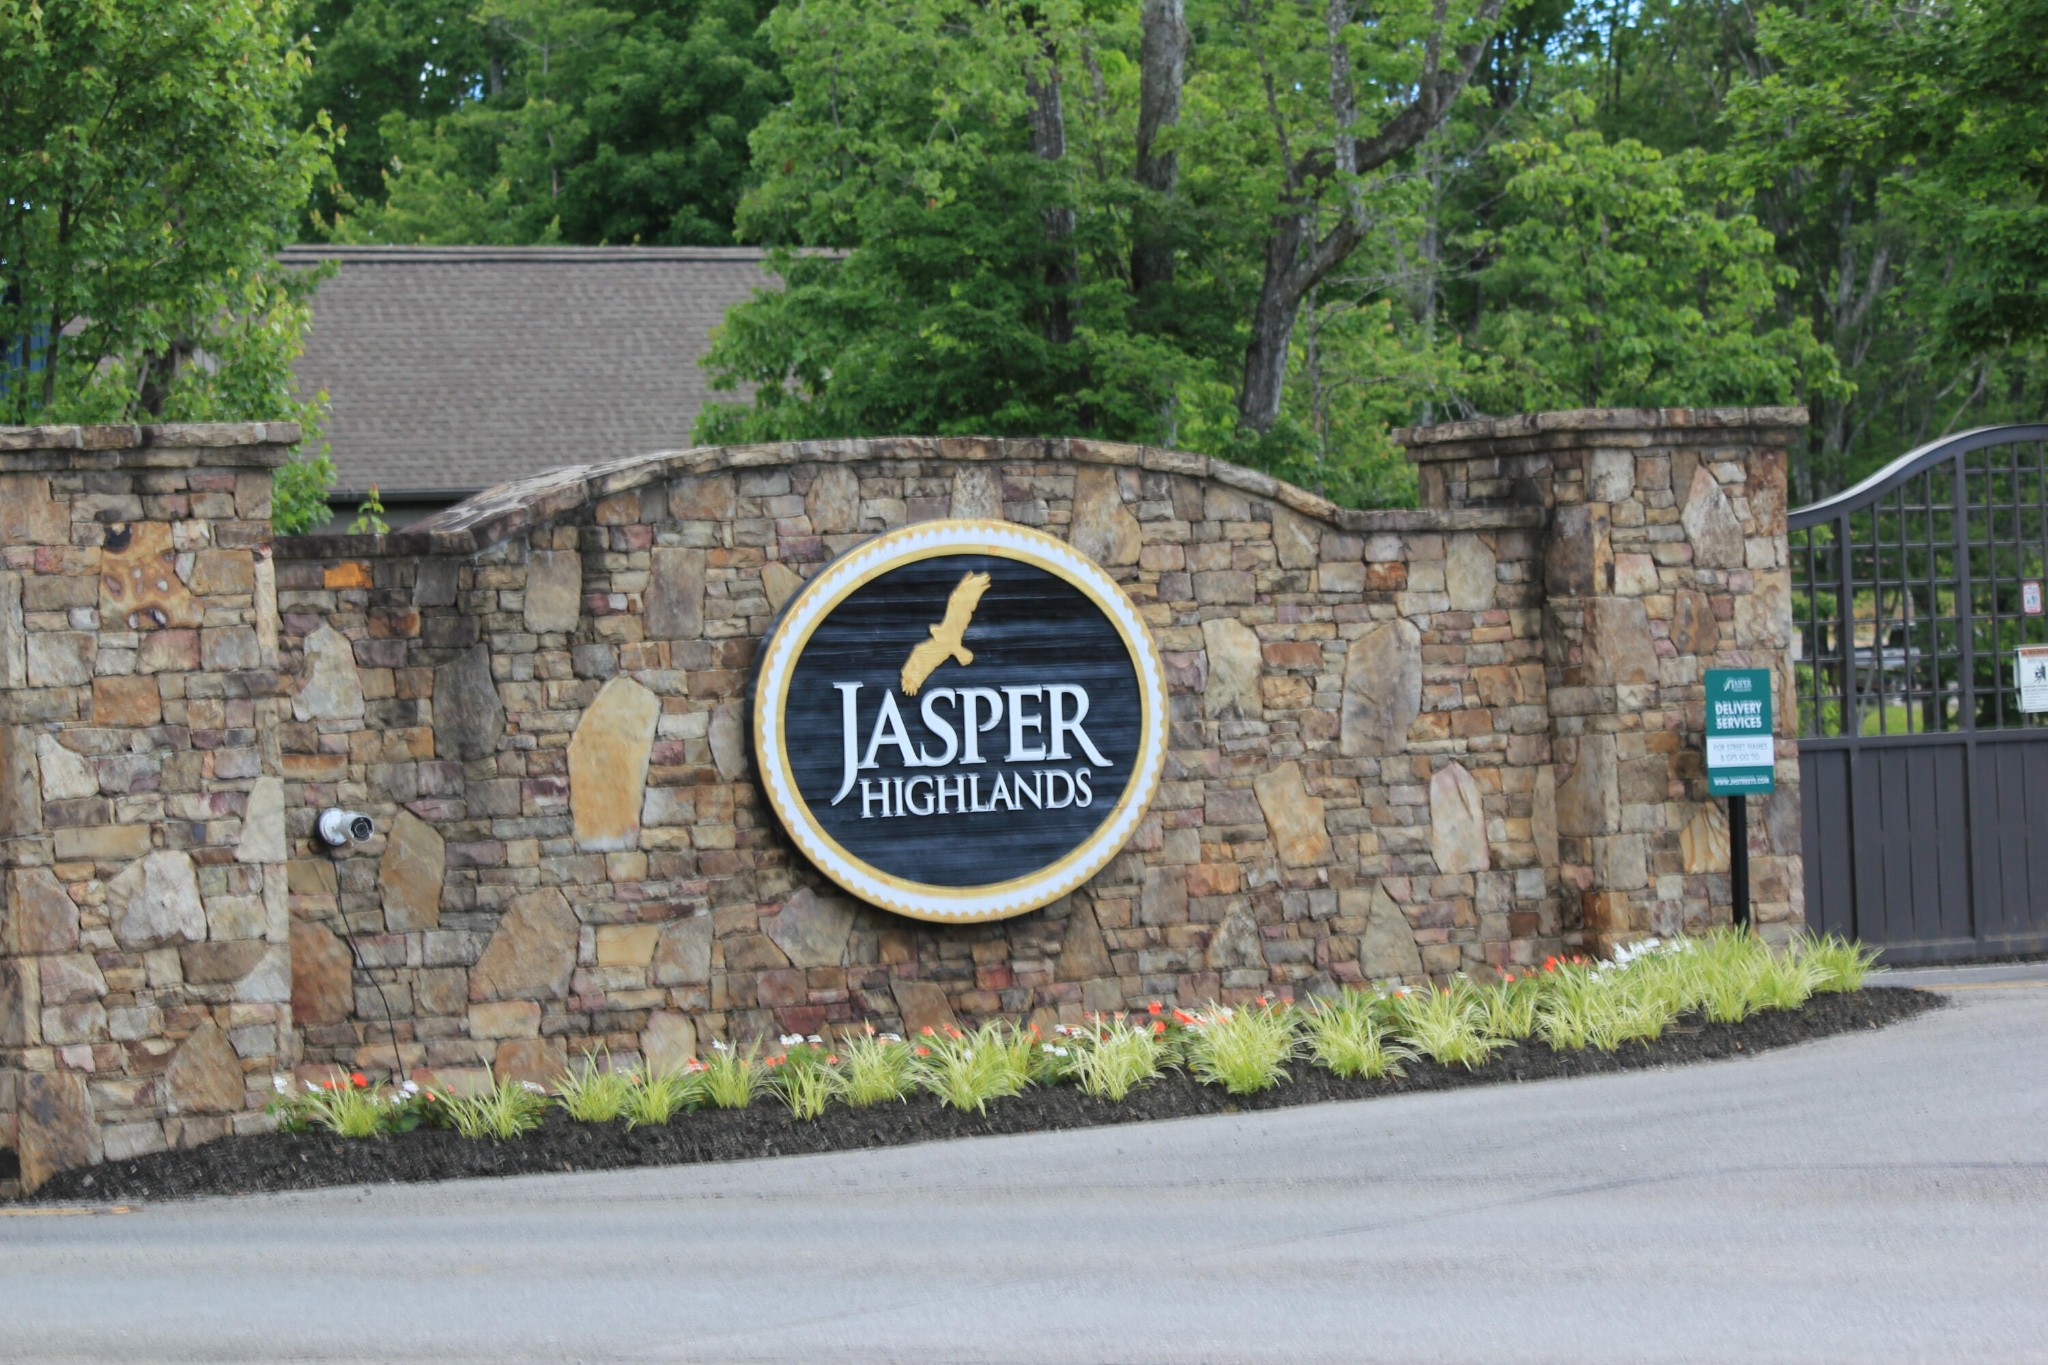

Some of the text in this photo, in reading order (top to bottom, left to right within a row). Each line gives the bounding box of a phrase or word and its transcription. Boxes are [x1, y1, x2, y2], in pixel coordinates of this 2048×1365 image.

[1714, 701, 1762, 715] DELIVERY
[1716, 715, 1762, 729] SERVICES
[831, 681, 1113, 806] JASPER
[1727, 743, 1745, 751] STREET
[1747, 742, 1768, 750] NAMES
[858, 767, 1093, 819] HIGHLANDS
